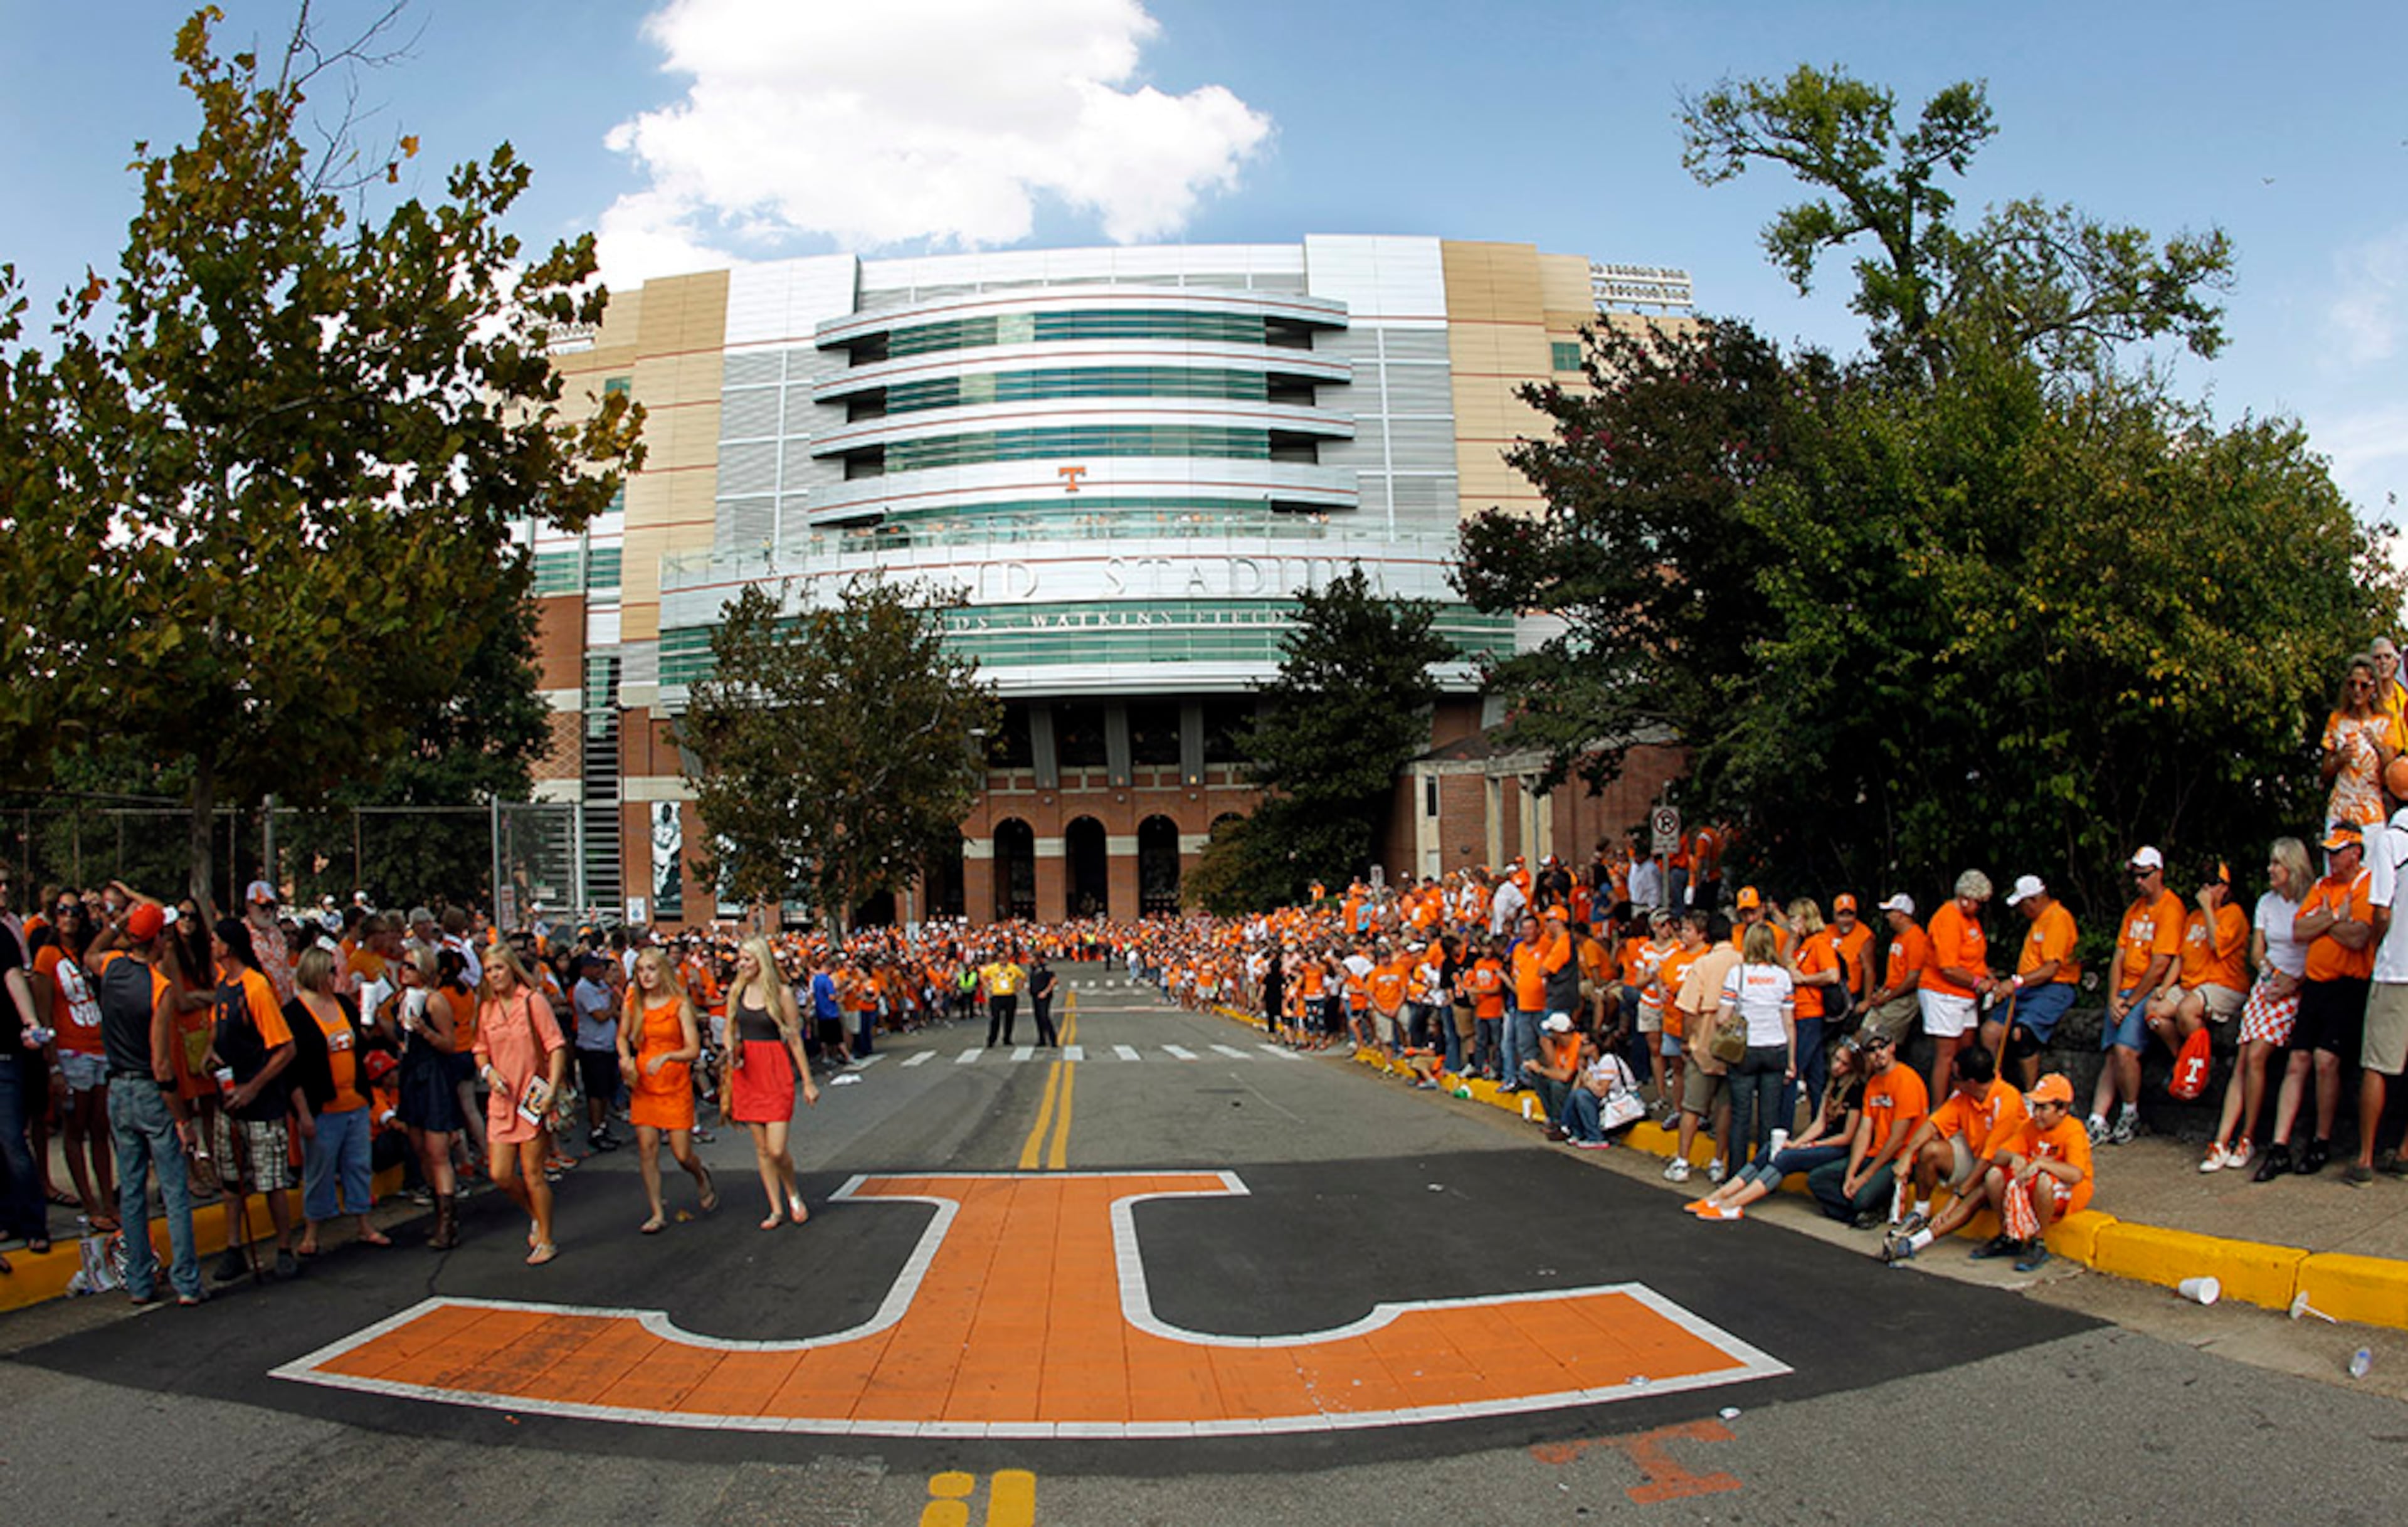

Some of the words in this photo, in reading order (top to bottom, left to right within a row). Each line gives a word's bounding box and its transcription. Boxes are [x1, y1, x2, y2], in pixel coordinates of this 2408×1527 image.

[1059, 466, 1087, 492] T
[1030, 611, 1173, 628] WATKINS
[1195, 611, 1286, 627] FIELD
[2185, 1057, 2204, 1083] T
[268, 1171, 1792, 1437] T
